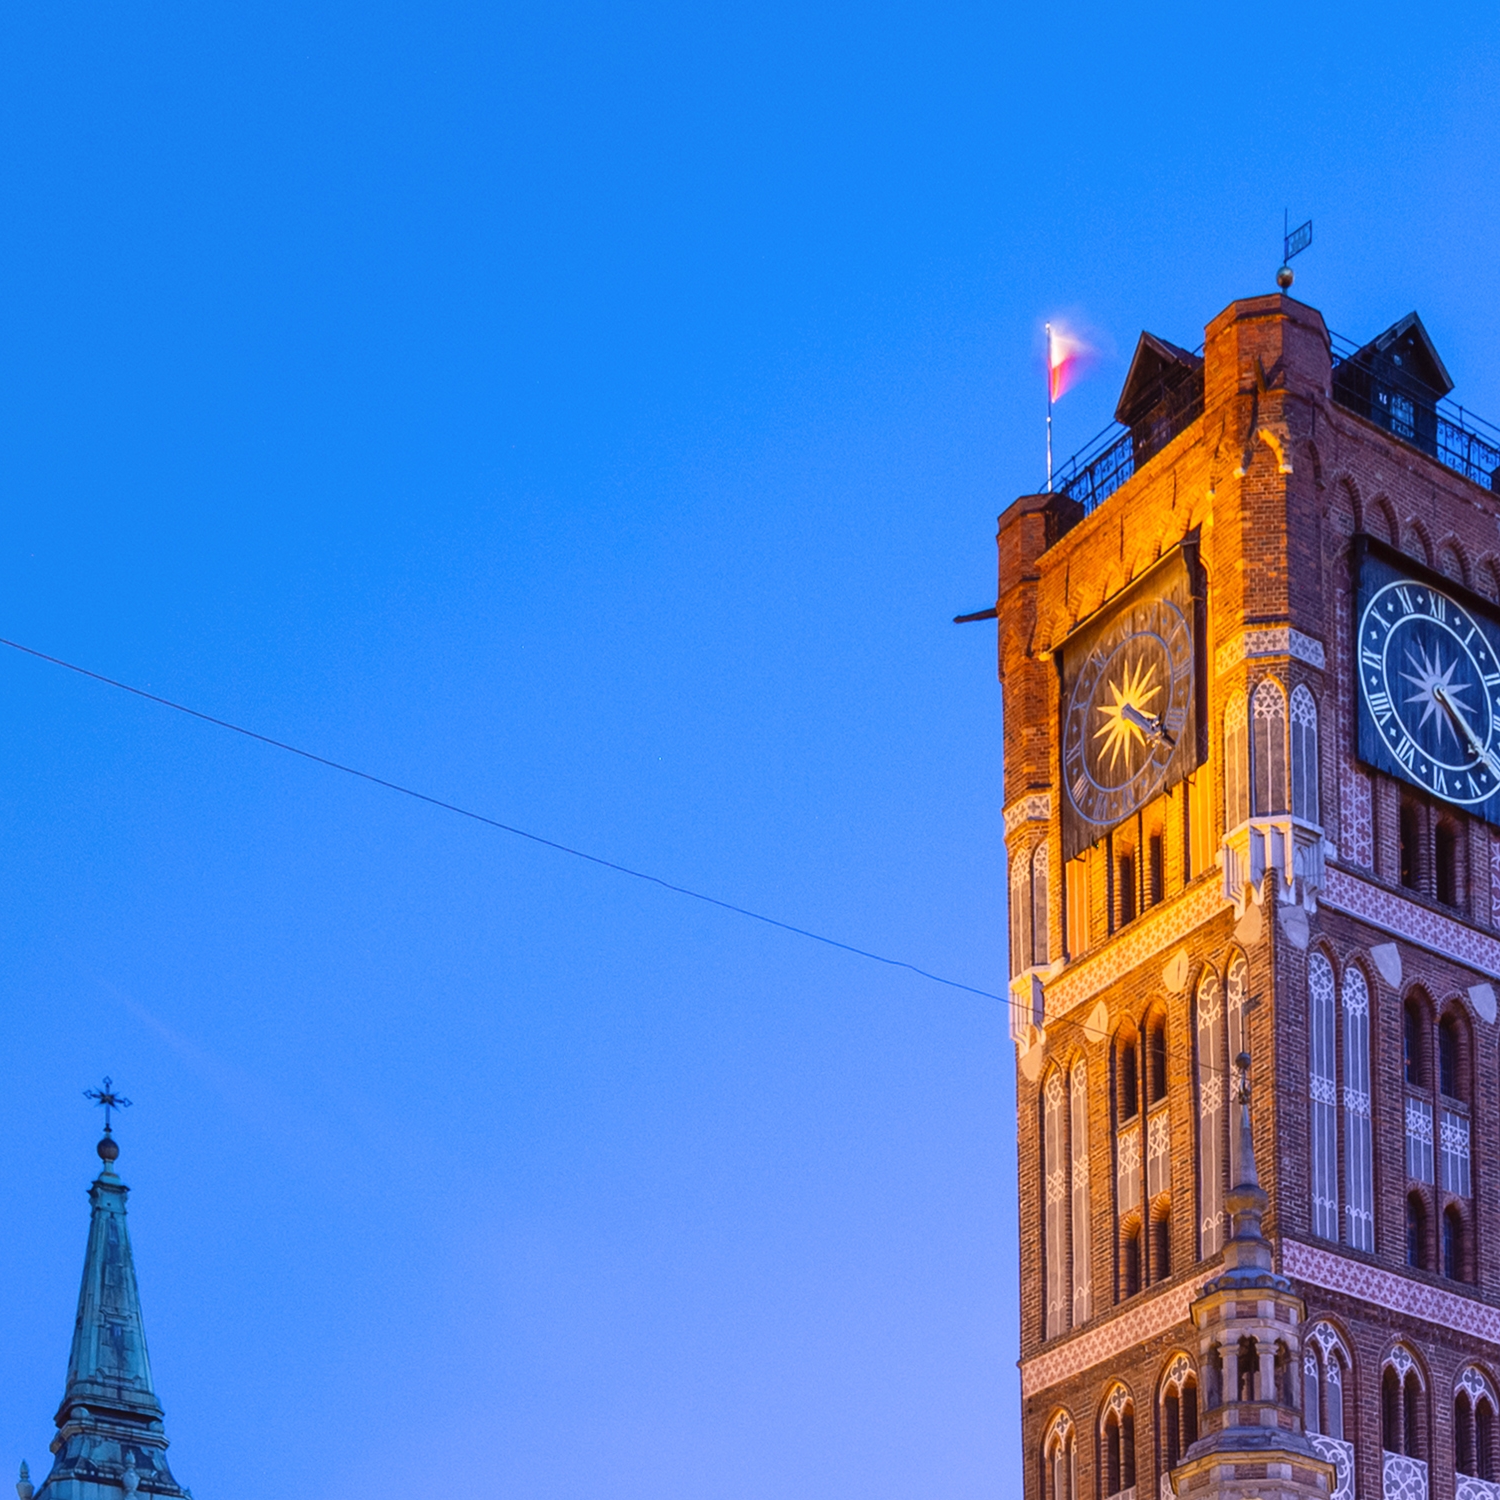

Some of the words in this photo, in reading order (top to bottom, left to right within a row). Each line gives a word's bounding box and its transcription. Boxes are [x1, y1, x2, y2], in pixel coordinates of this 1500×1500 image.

[1395, 586, 1415, 615] XI
[1428, 589, 1446, 622] XII
[1370, 605, 1391, 632] X
[1464, 627, 1476, 645] I
[1362, 645, 1382, 670] IX
[1369, 692, 1393, 726] VIII
[1395, 735, 1415, 770] VII
[1433, 765, 1448, 795] VI
[1467, 771, 1482, 798] V
